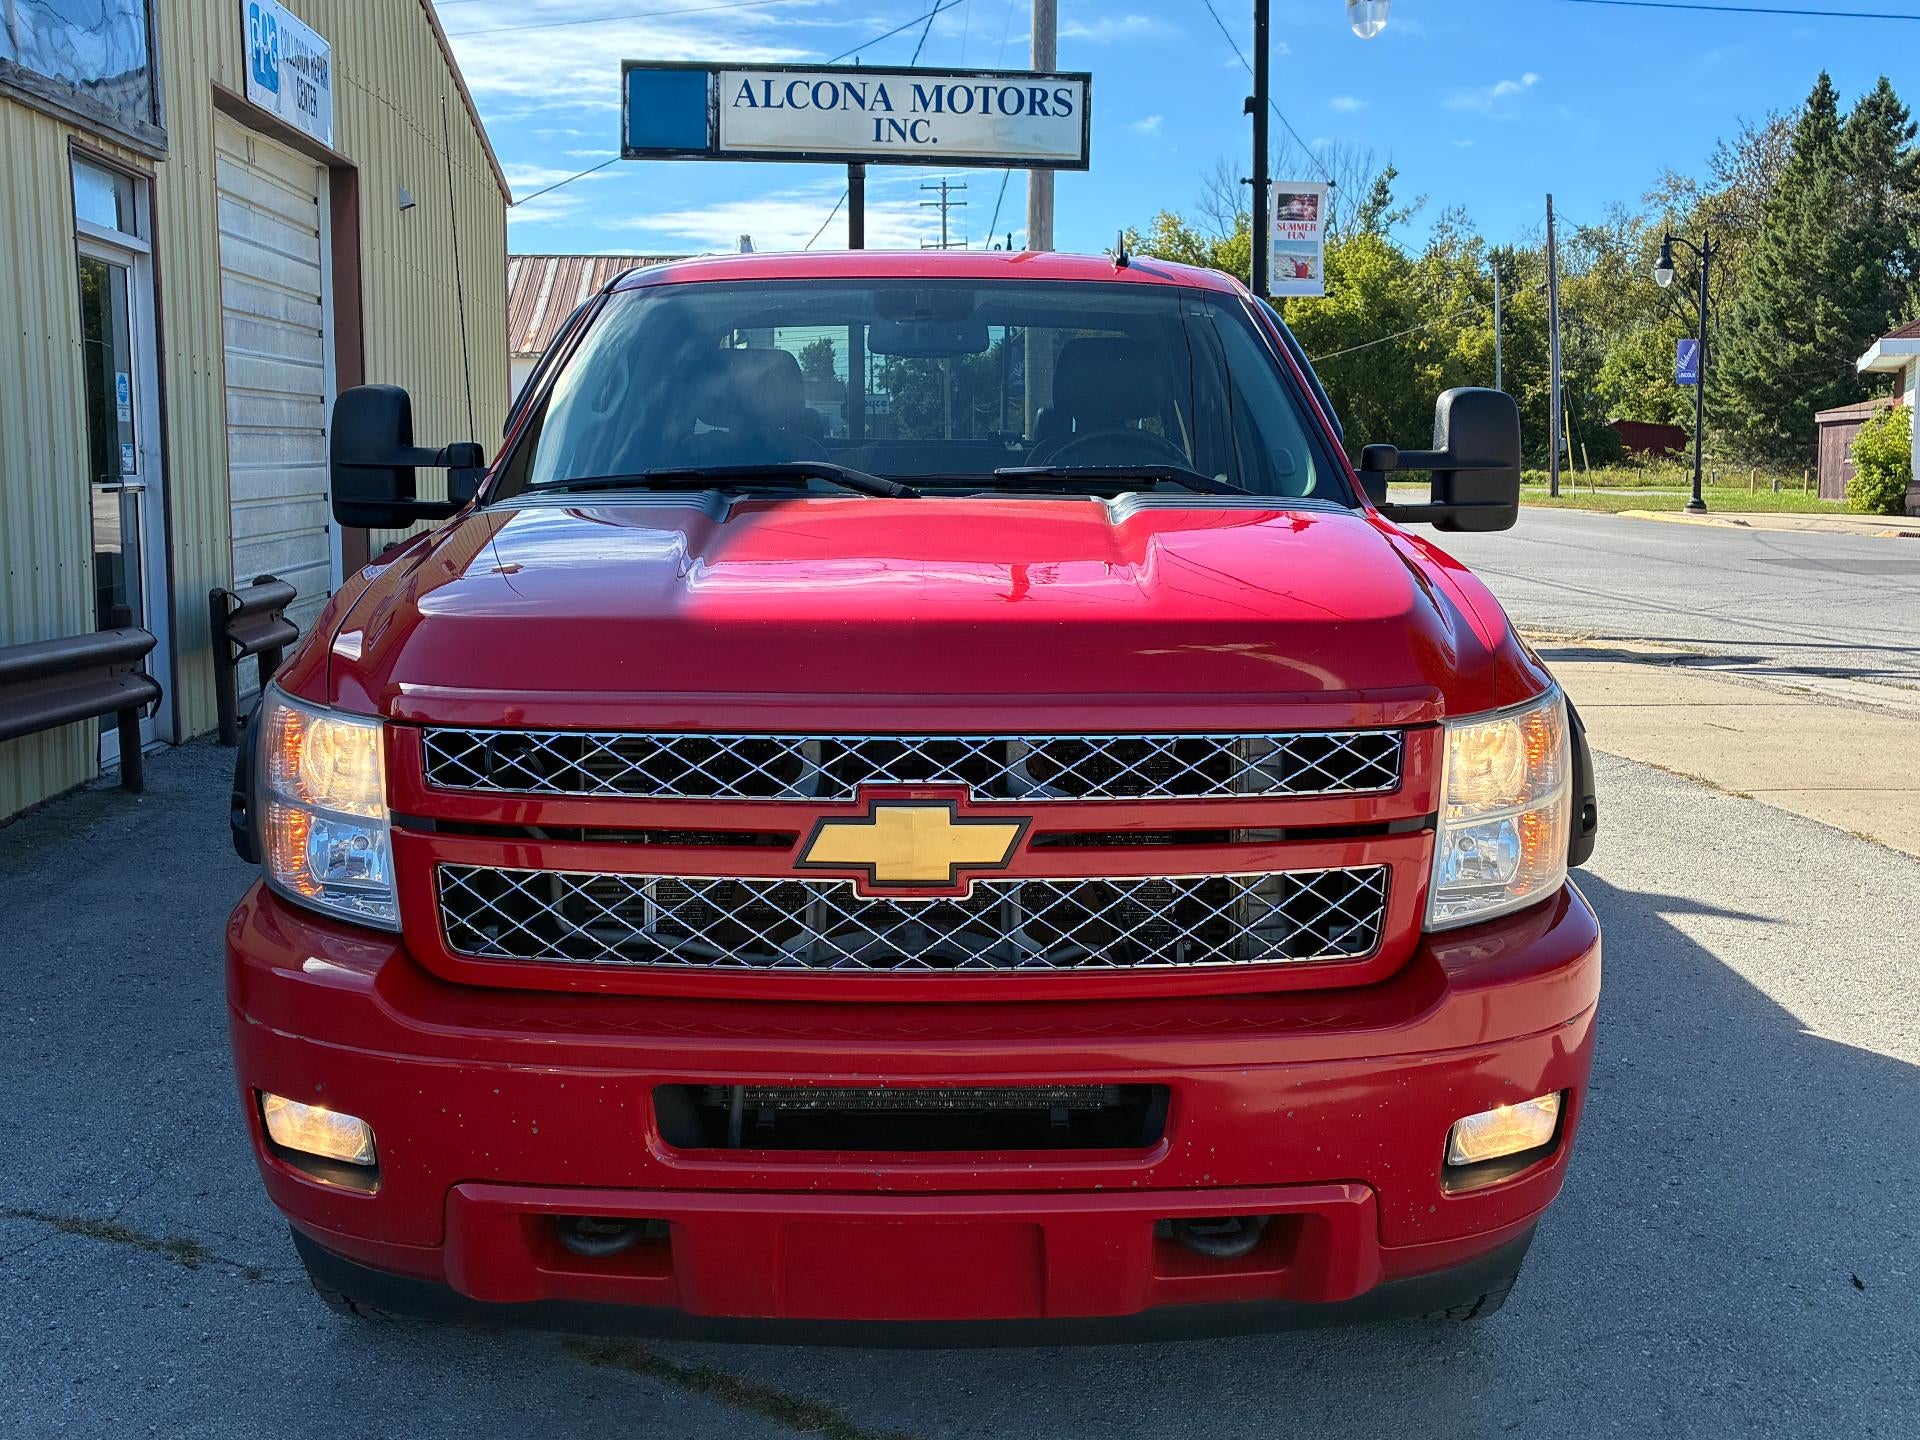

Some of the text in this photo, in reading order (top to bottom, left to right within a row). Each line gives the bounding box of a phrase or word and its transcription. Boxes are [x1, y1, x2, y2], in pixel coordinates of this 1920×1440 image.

[250, 8, 278, 75] PPG
[280, 25, 329, 91] COLLISION REPAIR
[296, 75, 318, 119] CENTER
[732, 78, 1074, 118] ALCONA MOTORS
[871, 117, 938, 144] INC.
[1277, 223, 1316, 231] SUMMER
[1287, 231, 1306, 240] FUN
[1677, 343, 1696, 370] Welcome
